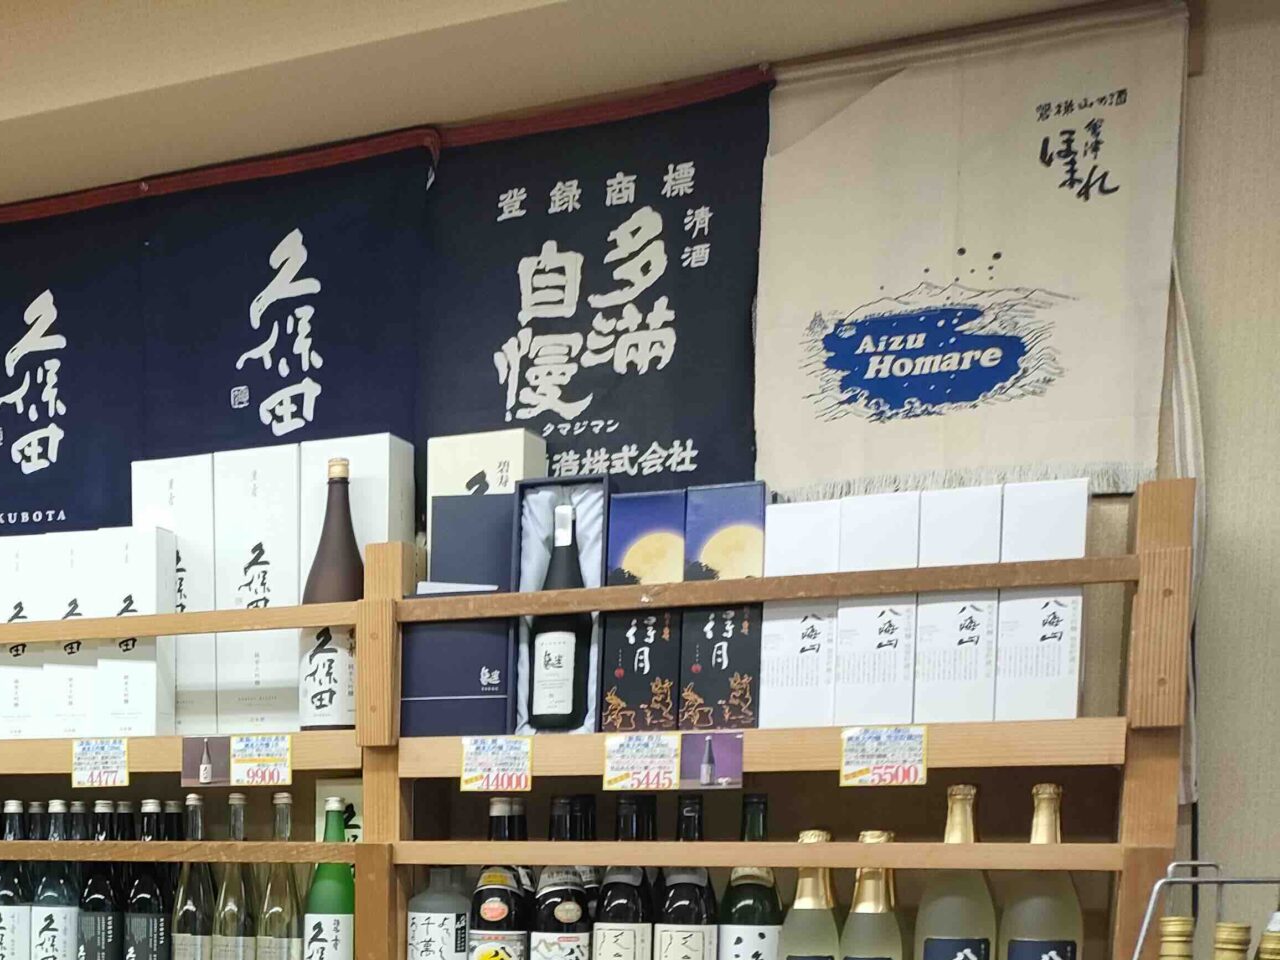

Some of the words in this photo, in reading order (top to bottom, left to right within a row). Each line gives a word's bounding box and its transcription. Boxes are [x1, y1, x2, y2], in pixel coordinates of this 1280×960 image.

[1039, 128, 1120, 202] ほまれ
[496, 161, 695, 222] 登録商標
[680, 205, 714, 267] 清酒
[236, 228, 323, 437] 久保田
[493, 239, 594, 422] 自慢
[854, 329, 927, 355] Aizu
[863, 346, 1004, 380] Homare
[546, 438, 698, 477] 造株式会社
[305, 626, 338, 710] 久保田
[87, 770, 119, 786] 4477
[246, 768, 281, 785] 9900
[481, 772, 529, 791] 44000
[630, 771, 673, 789] 5445
[870, 766, 919, 785] 5500
